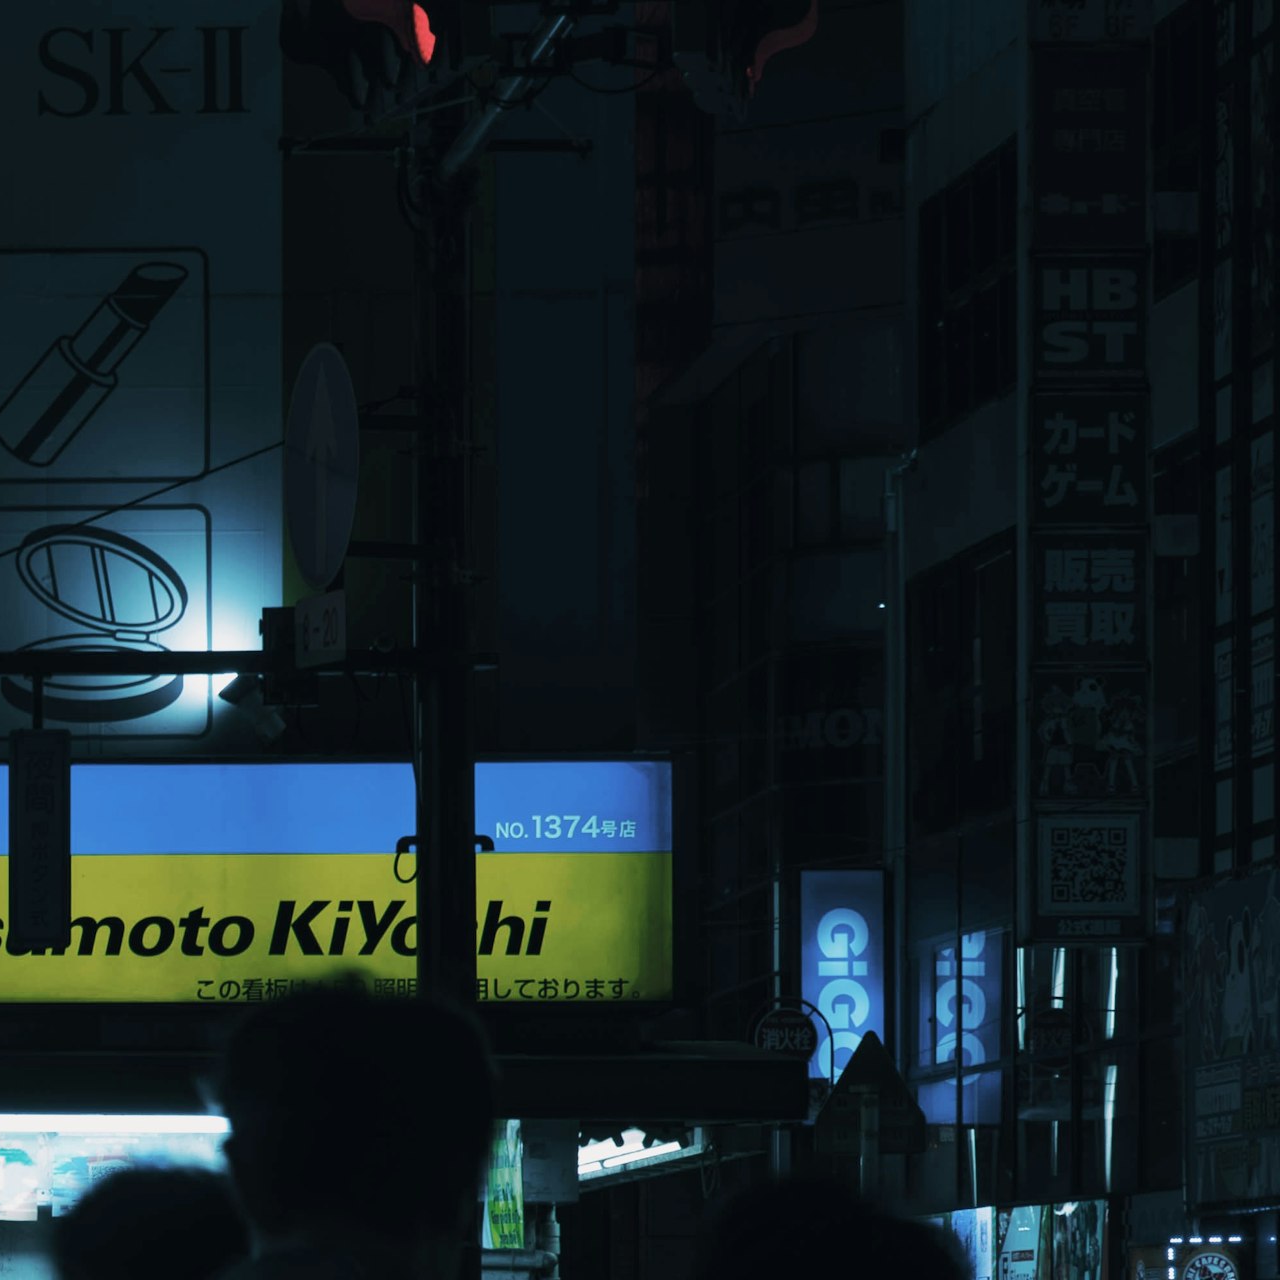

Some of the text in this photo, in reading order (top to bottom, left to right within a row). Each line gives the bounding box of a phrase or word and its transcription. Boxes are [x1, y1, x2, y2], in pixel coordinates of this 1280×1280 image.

[1042, 412, 1137, 456] カード
[1040, 464, 1139, 509] ゲーム
[1044, 548, 1136, 593] 販売
[1043, 600, 1136, 646] 買取
